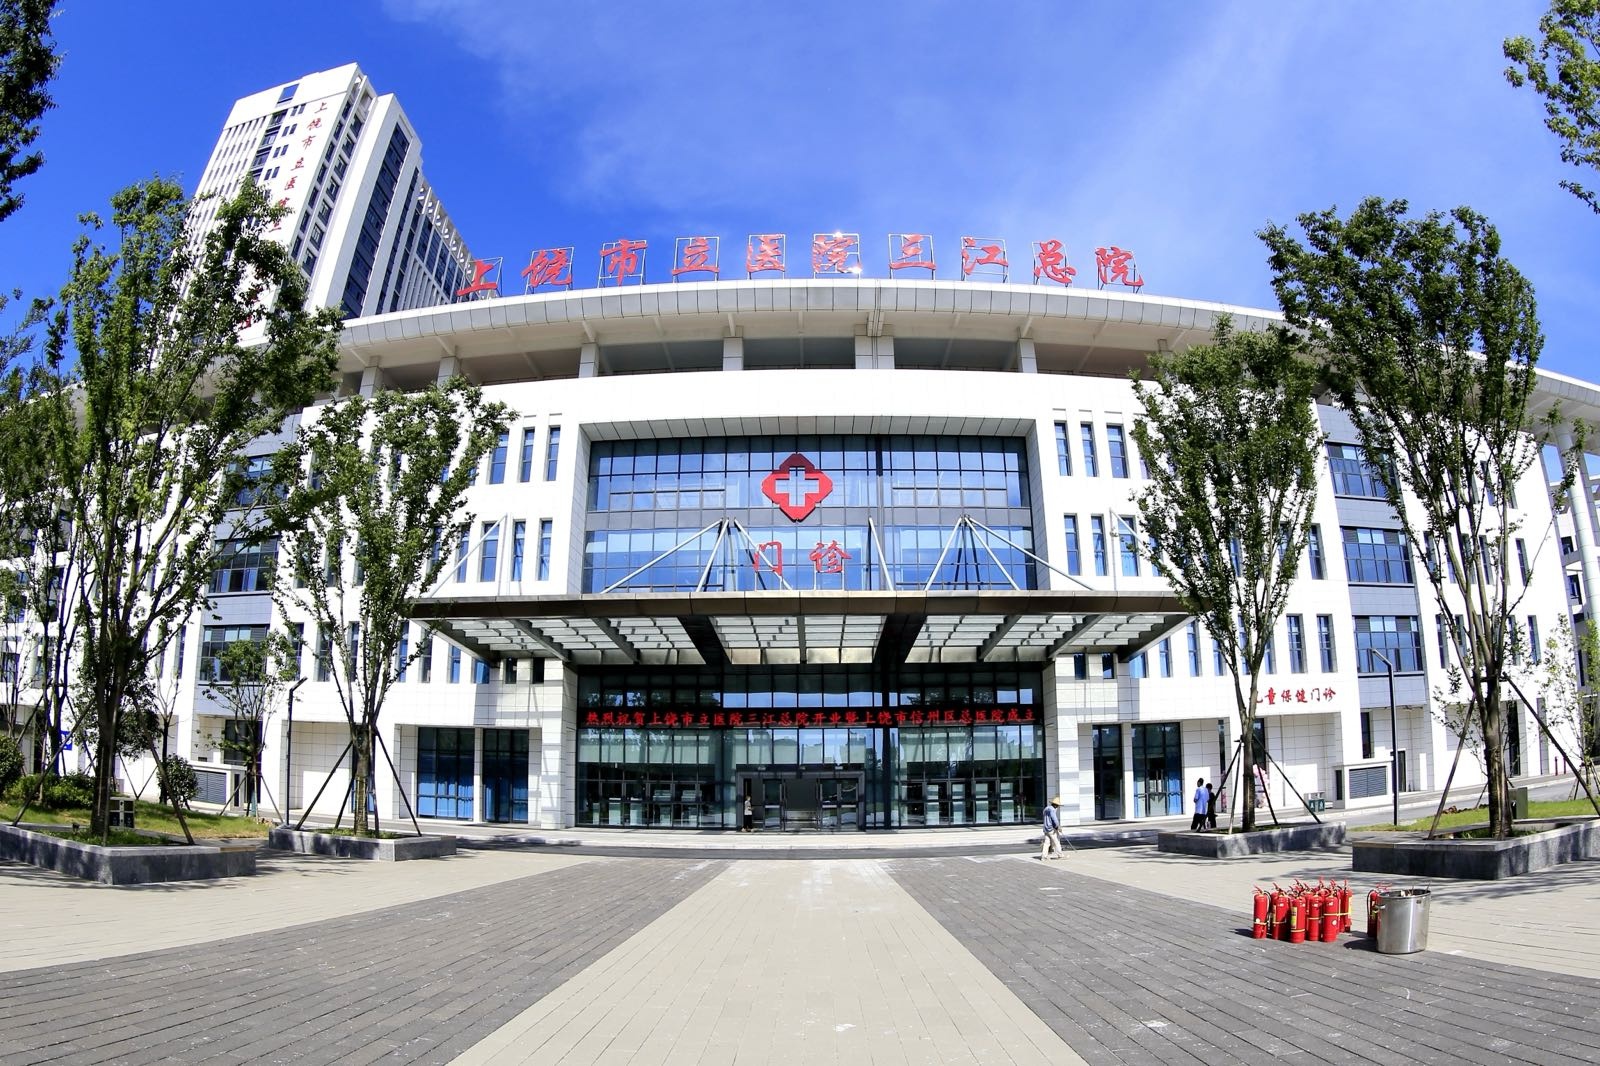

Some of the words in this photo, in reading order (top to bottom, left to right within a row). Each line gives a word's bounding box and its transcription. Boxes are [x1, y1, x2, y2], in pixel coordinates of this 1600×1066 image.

[457, 233, 1144, 296] 上饶市立医院三江总院
[753, 540, 852, 576] 门诊
